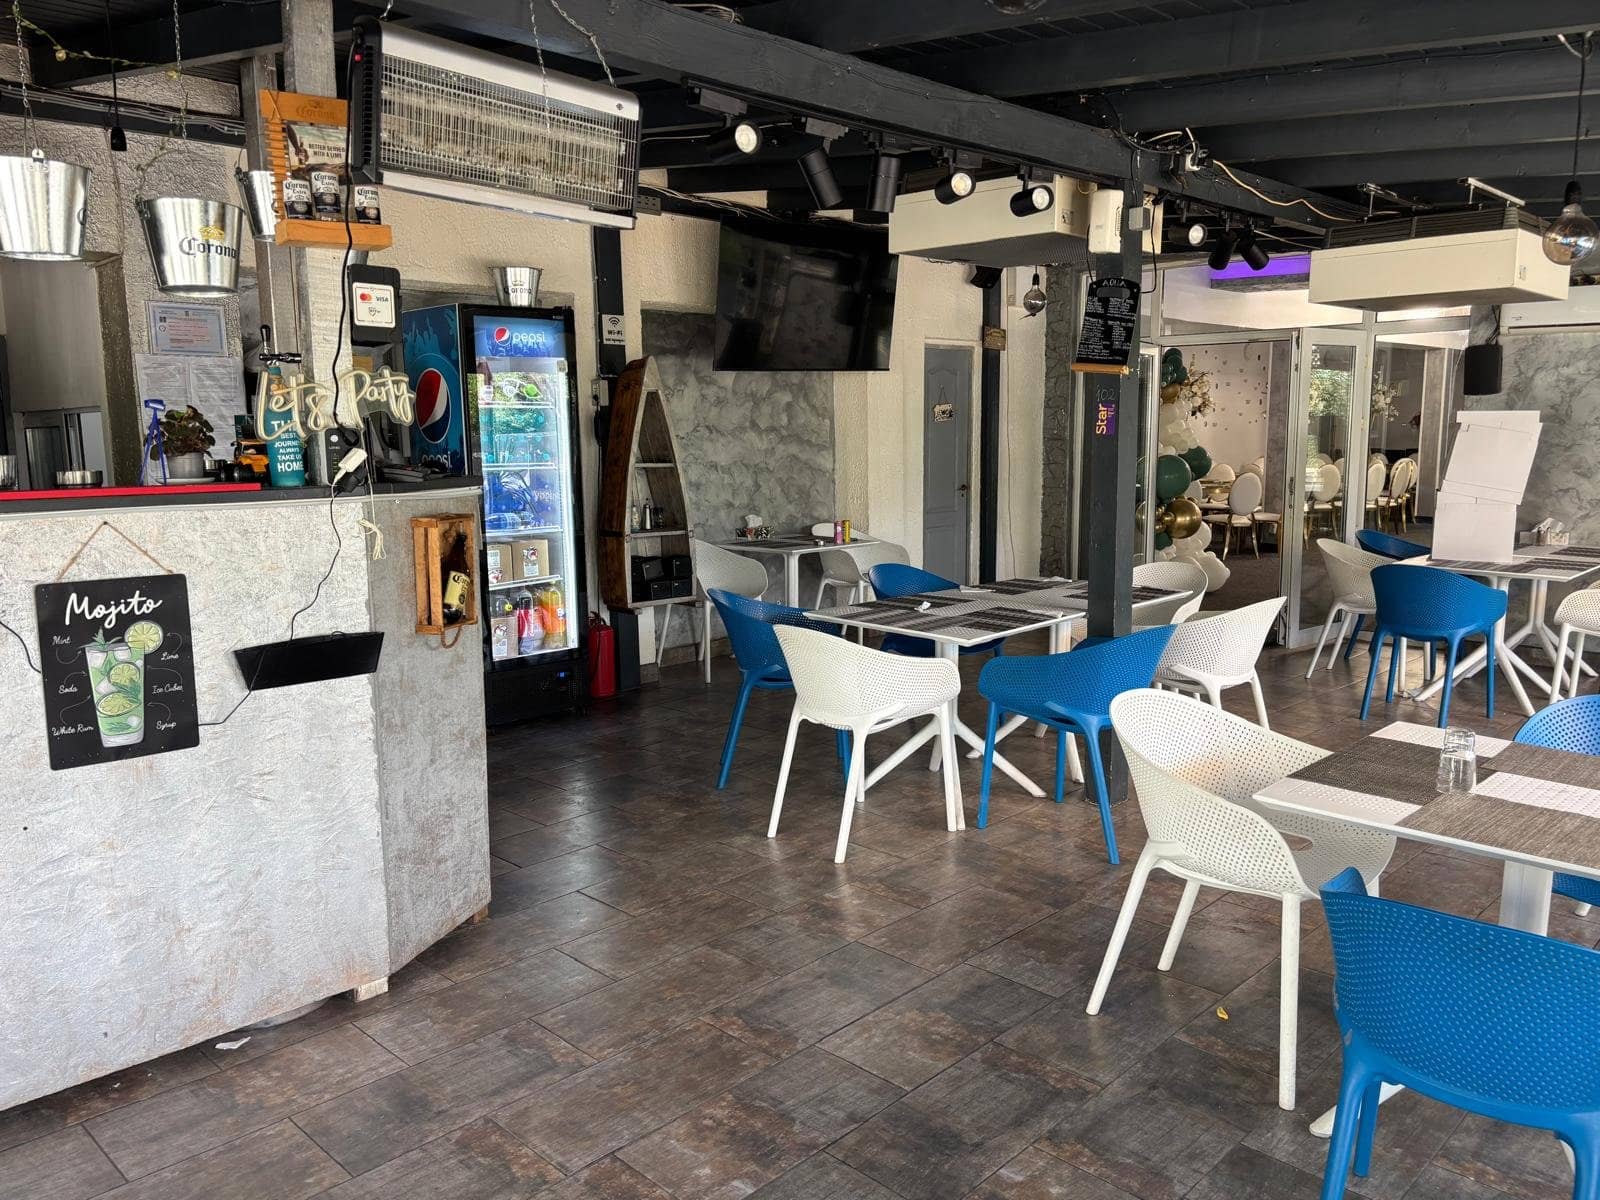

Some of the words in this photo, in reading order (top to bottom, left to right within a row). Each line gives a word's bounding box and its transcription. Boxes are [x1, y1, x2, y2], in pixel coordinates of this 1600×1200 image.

[512, 331, 545, 344] pepsi
[339, 369, 415, 428] Party
[1096, 403, 1108, 435] Star
[277, 454, 295, 462] TAKE
[277, 461, 304, 472] HOME
[65, 590, 163, 628] Mojito
[52, 635, 71, 645] Mint
[160, 651, 179, 661] Lime
[58, 684, 78, 694] Soda
[164, 683, 183, 693] Cubes
[51, 726, 76, 736] White
[77, 723, 94, 733] Rum
[156, 720, 177, 731] Syrup
